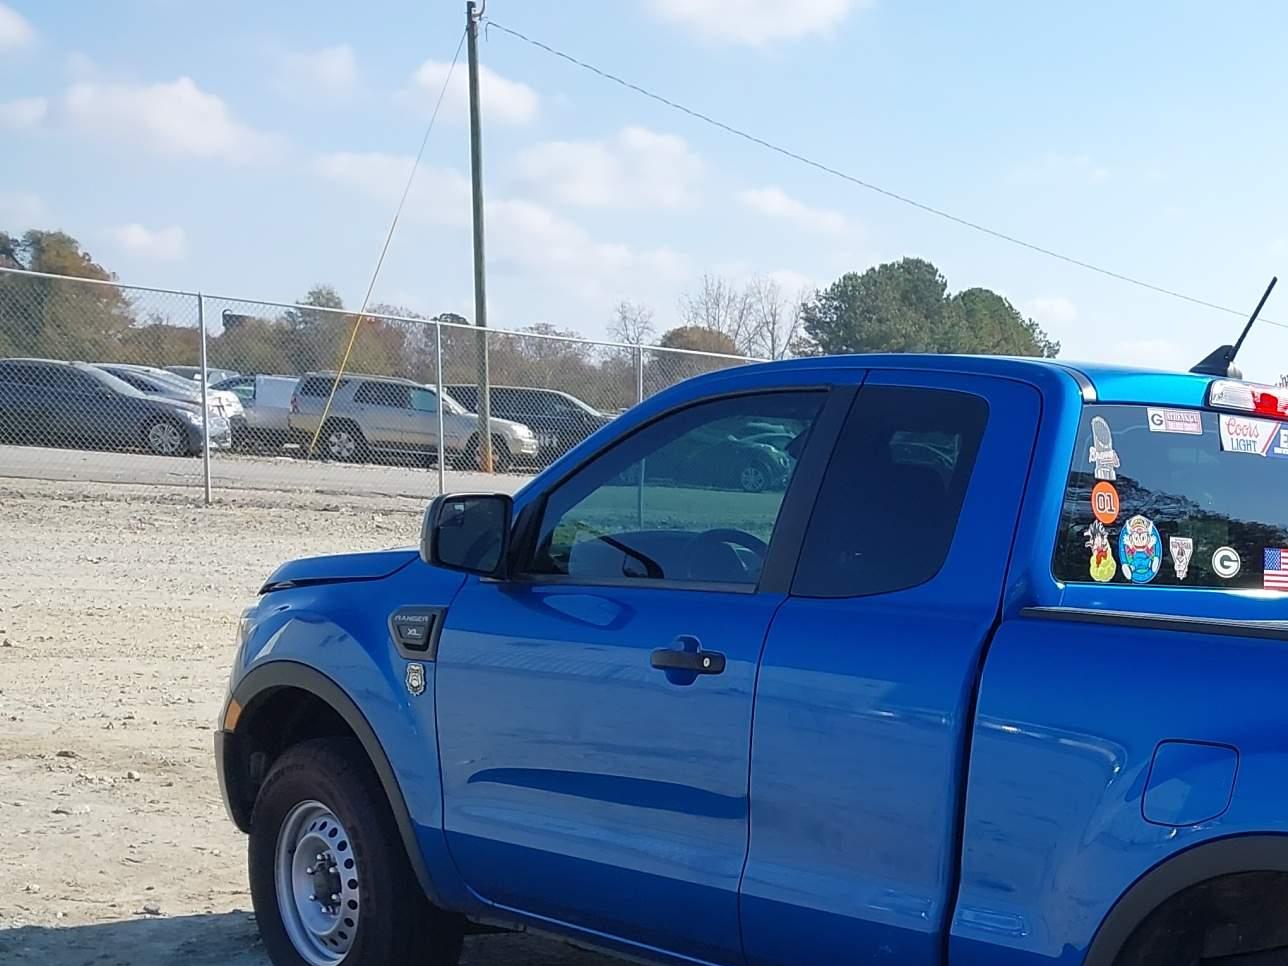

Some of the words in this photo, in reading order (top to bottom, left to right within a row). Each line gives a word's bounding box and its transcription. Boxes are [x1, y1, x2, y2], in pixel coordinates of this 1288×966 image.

[1225, 417, 1260, 439] Coors
[1230, 437, 1257, 452] LIGHT
[1095, 492, 1116, 514] 01
